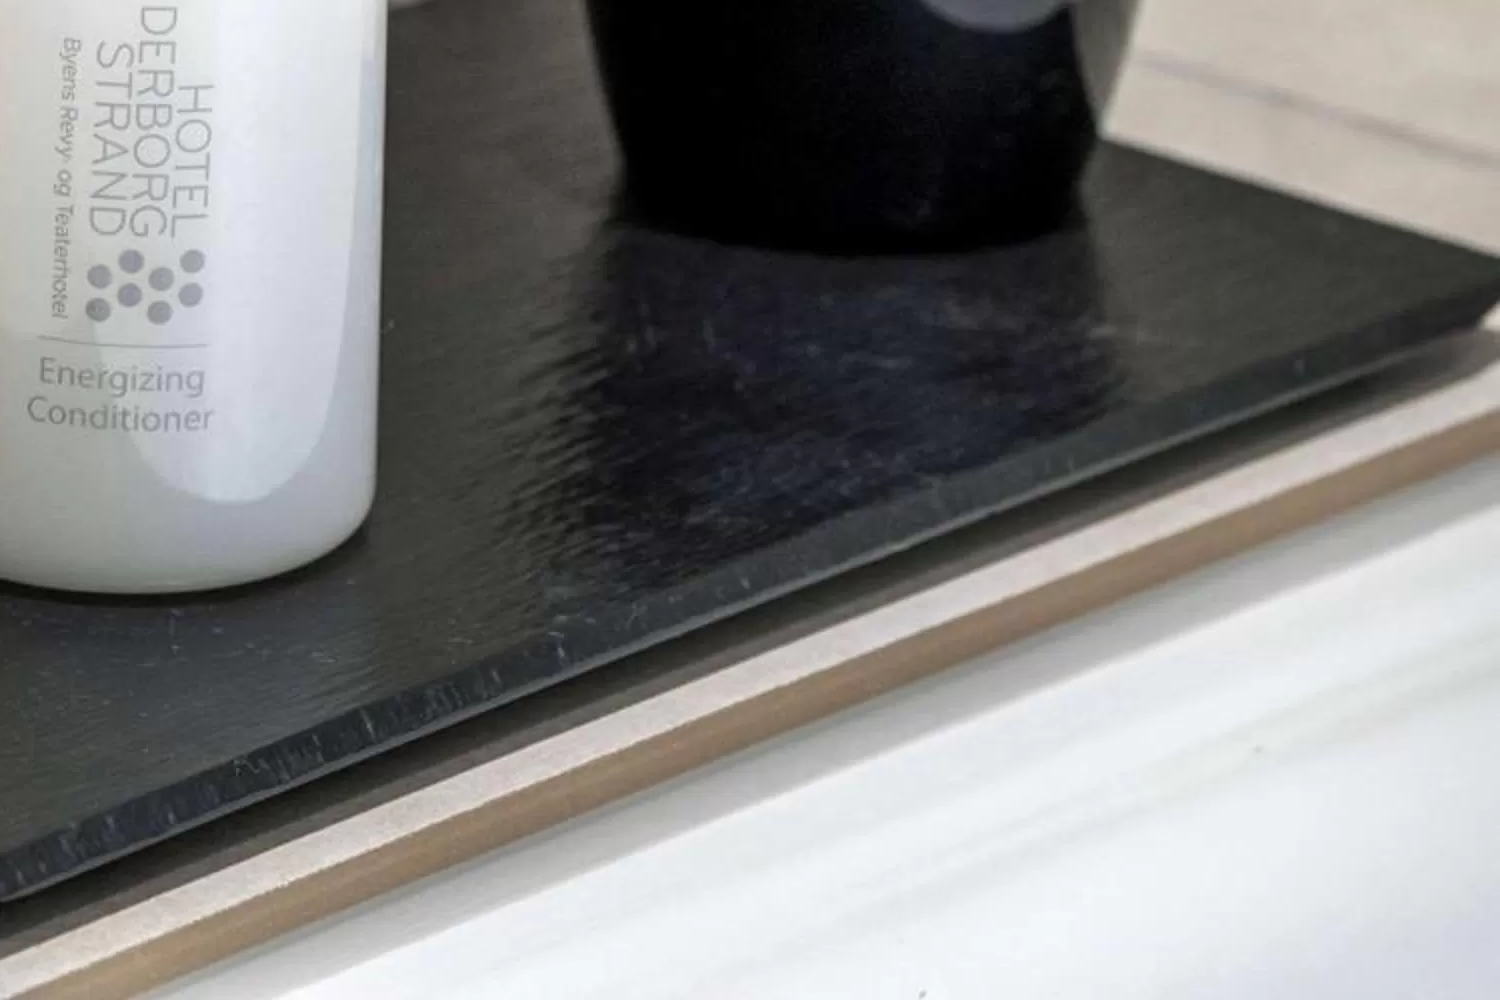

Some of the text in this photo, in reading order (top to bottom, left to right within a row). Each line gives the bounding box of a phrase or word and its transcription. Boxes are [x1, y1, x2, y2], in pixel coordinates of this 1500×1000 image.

[59, 36, 82, 101] Byens
[89, 40, 135, 238] STRAND
[169, 83, 214, 239] HOTEL
[54, 168, 75, 197] og
[39, 356, 206, 398] Energizing
[27, 395, 215, 432] Conditioner
